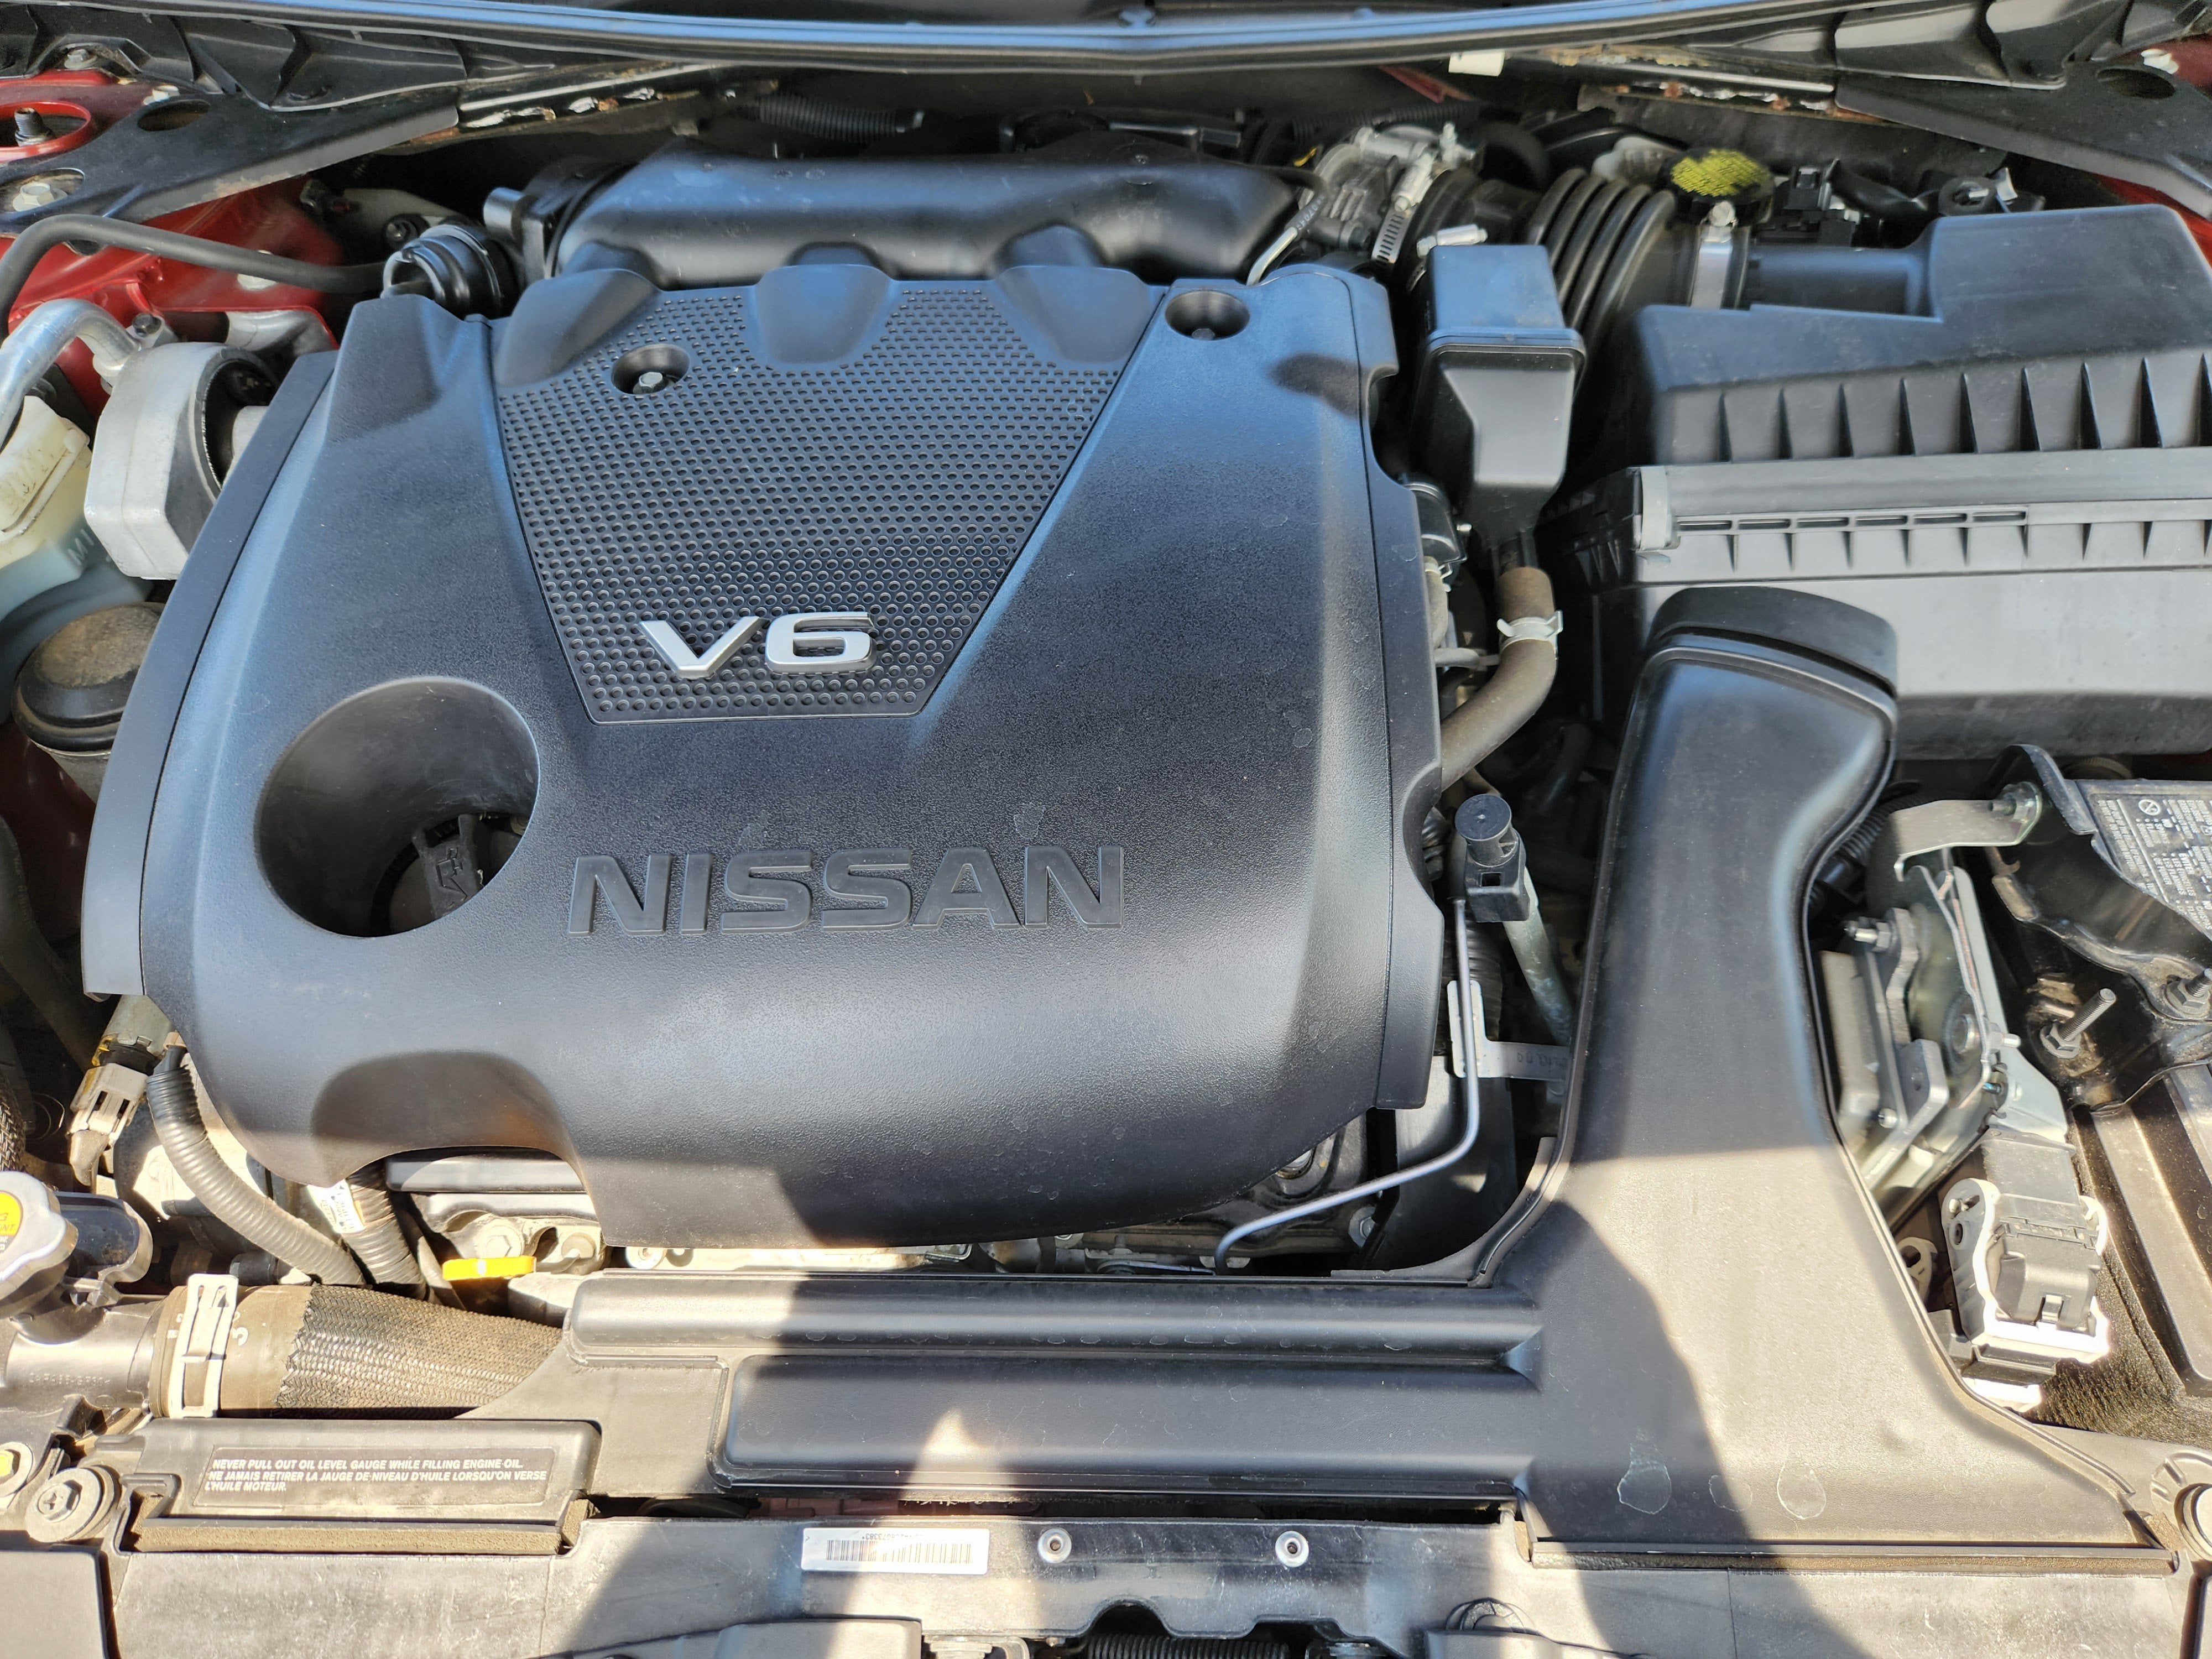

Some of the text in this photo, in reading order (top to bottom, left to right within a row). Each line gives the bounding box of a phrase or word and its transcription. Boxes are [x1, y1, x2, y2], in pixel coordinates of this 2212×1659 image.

[640, 611, 877, 680] V6
[567, 845, 1125, 937] NISSAN
[212, 1459, 523, 1470] NEVER PULL OUT OIL LEVEL GAUGE WHILE FILLING ENGINE OIL.
[208, 1470, 547, 1482] NE JAMAIS RETIRER LA JAUGE DE NIVEAU D'HUILE LORSQU'ON VERSE
[204, 1481, 287, 1492] L'HUILE MOTEUR.
